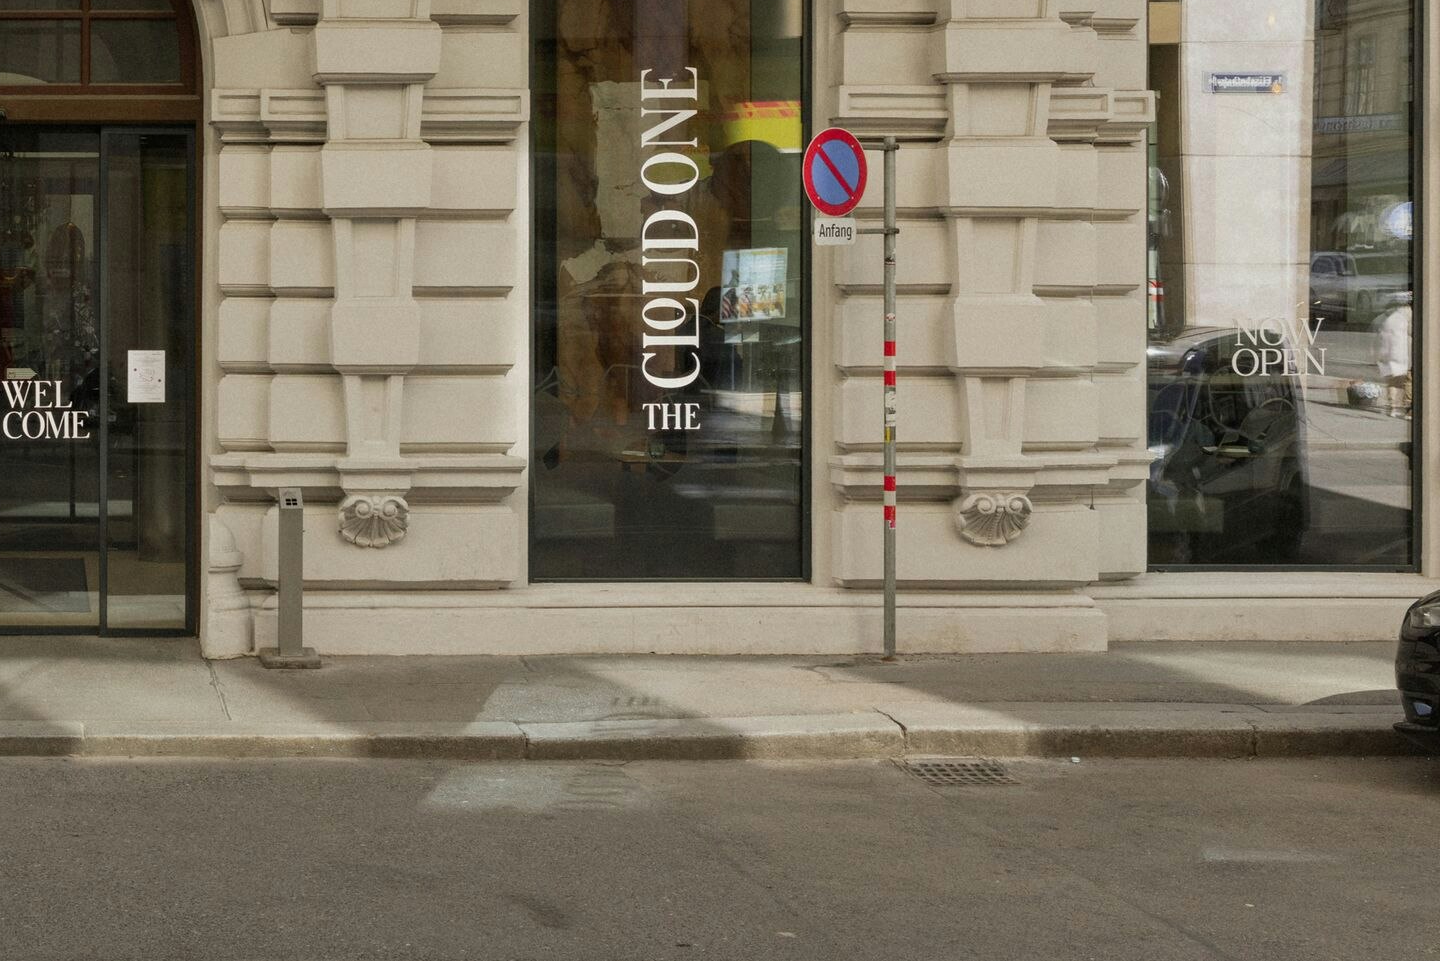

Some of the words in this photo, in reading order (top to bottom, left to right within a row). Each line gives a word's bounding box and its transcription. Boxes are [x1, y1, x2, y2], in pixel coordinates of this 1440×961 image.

[640, 66, 699, 195] ONE
[819, 223, 852, 241] Anfang
[641, 209, 701, 389] CLOUD
[1233, 317, 1326, 347] NOW
[1231, 347, 1328, 377] OPEN
[1, 380, 73, 409] WEL
[2, 410, 91, 440] COME
[642, 402, 701, 430] THE
